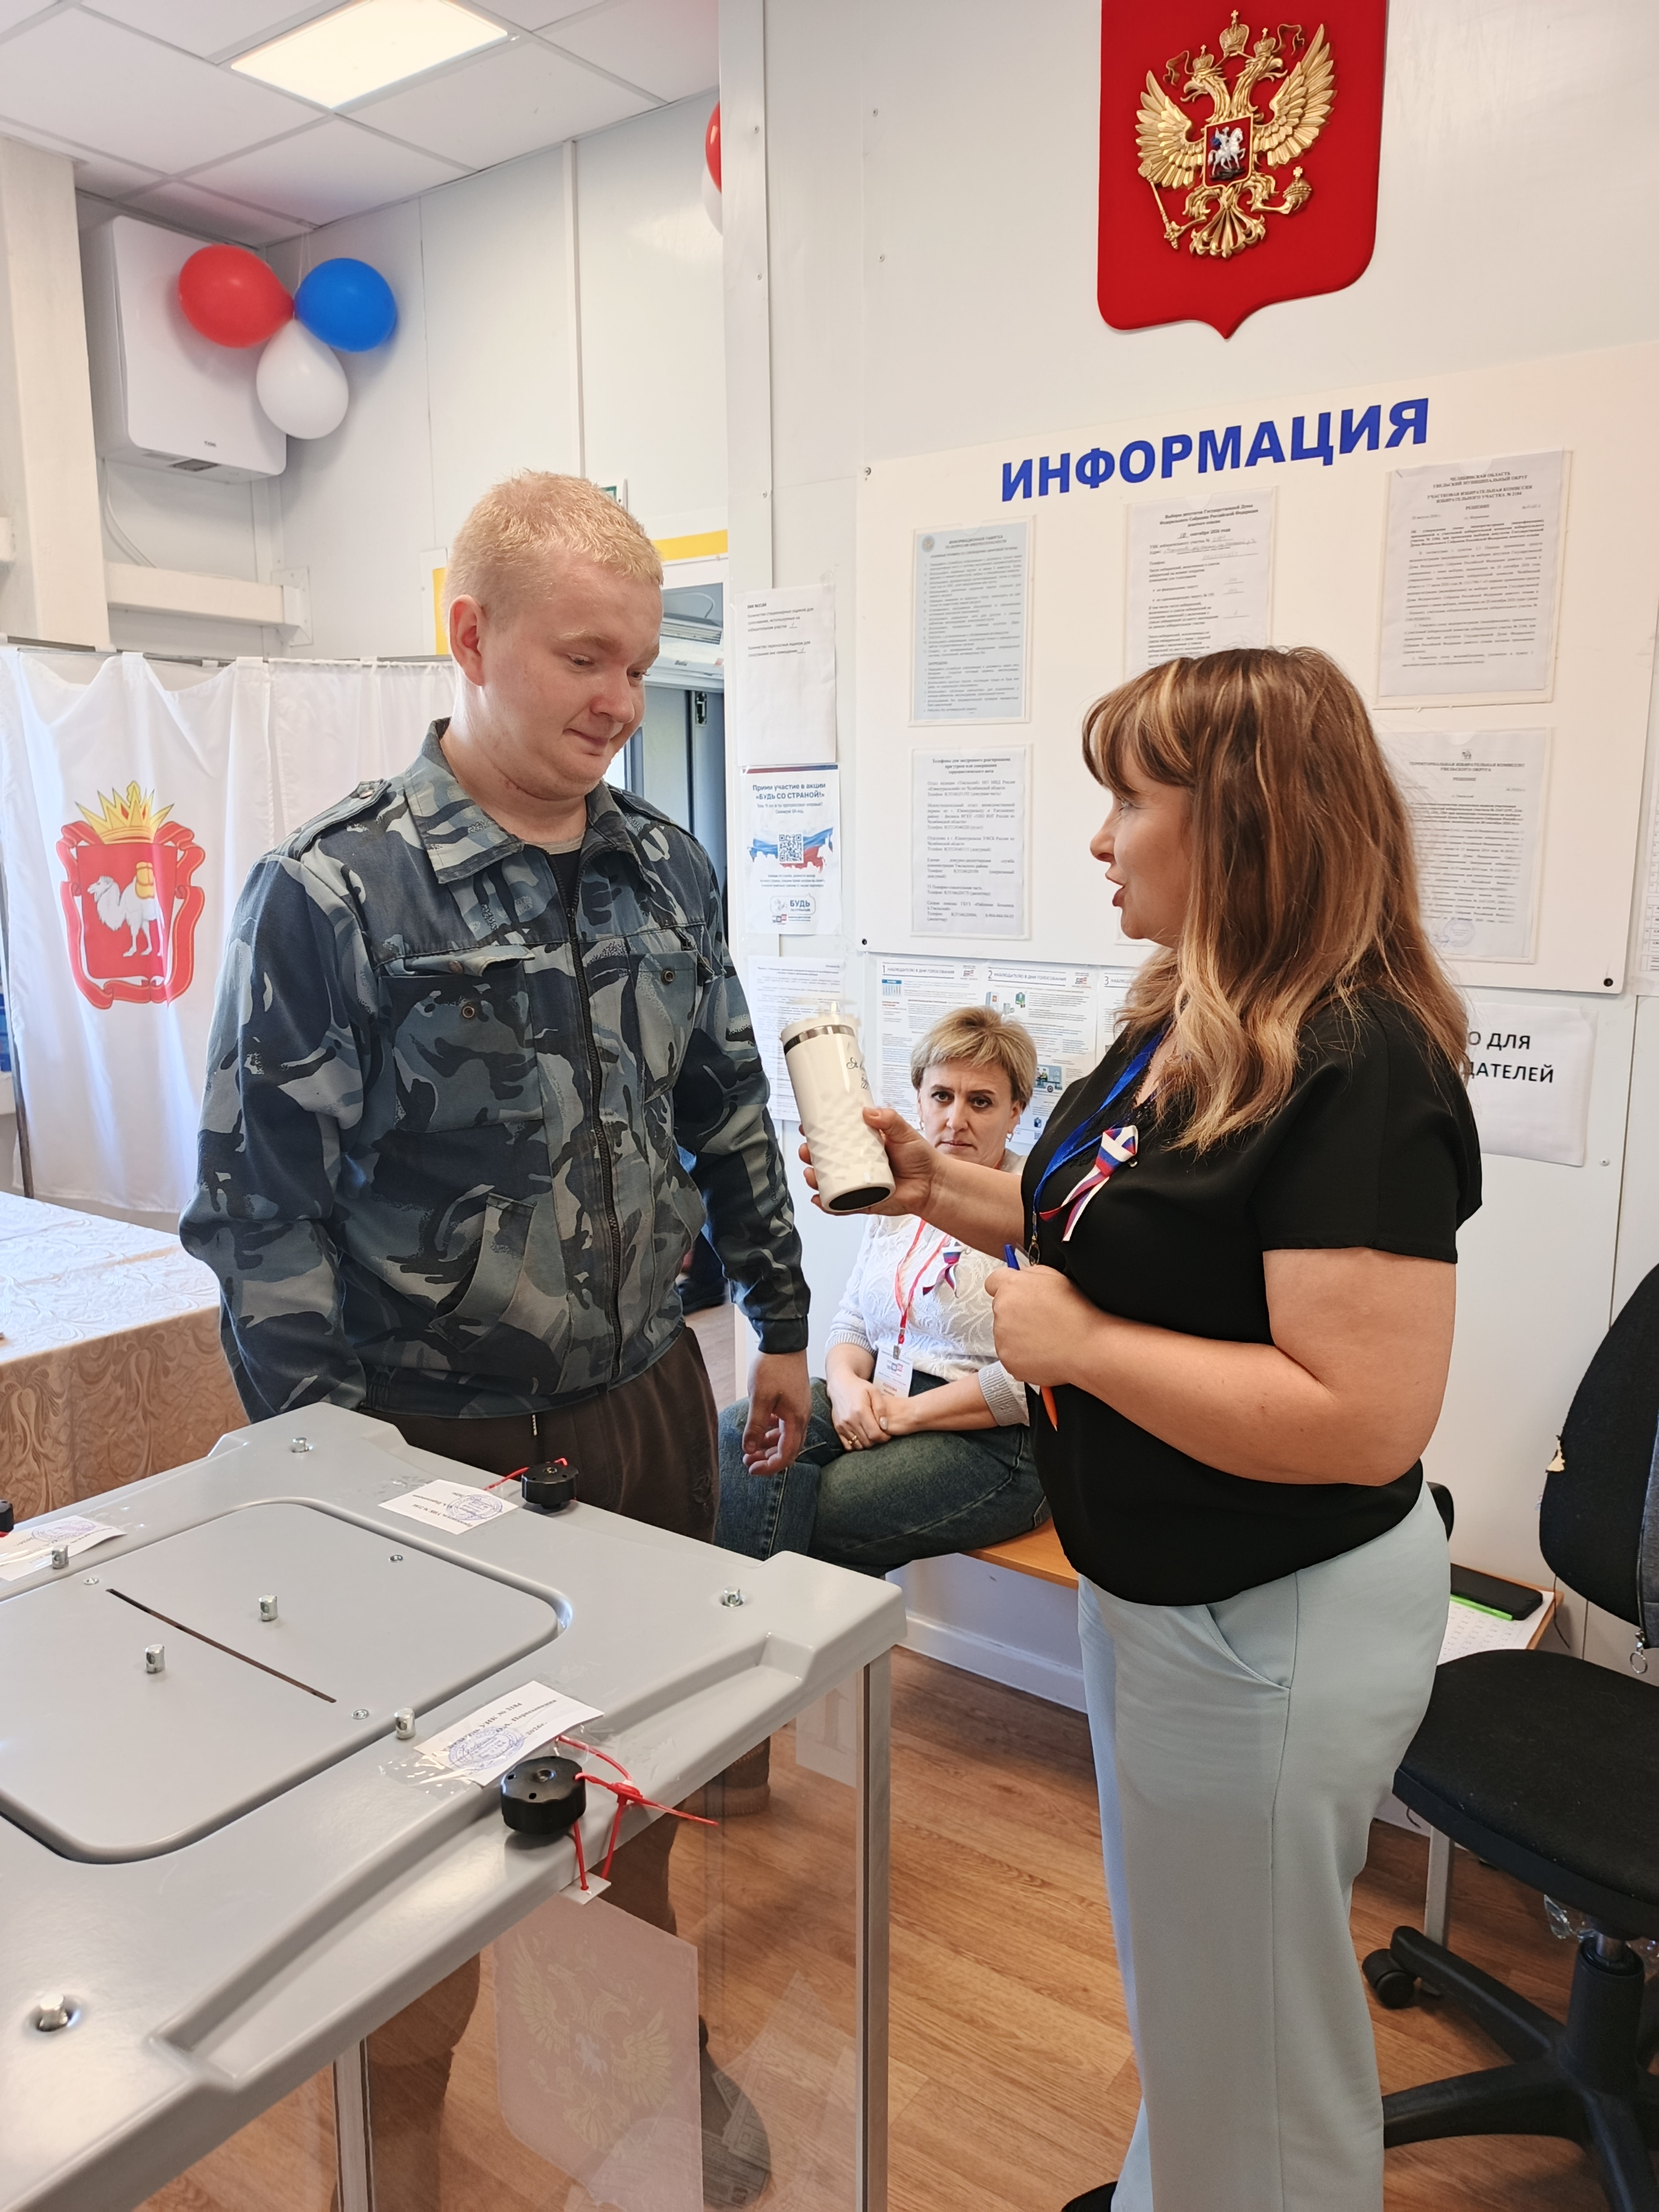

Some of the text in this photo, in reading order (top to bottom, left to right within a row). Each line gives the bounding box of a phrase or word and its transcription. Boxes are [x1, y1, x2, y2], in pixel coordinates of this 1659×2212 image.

[1002, 398, 1429, 502] ИНФОРМАЦИЯ
[988, 970, 992, 979] 2
[1104, 976, 1109, 985] 3
[1486, 1033, 1530, 1051] ДЛЯ
[479, 1715, 498, 1728] УИК
[506, 1702, 523, 1711] 2184
